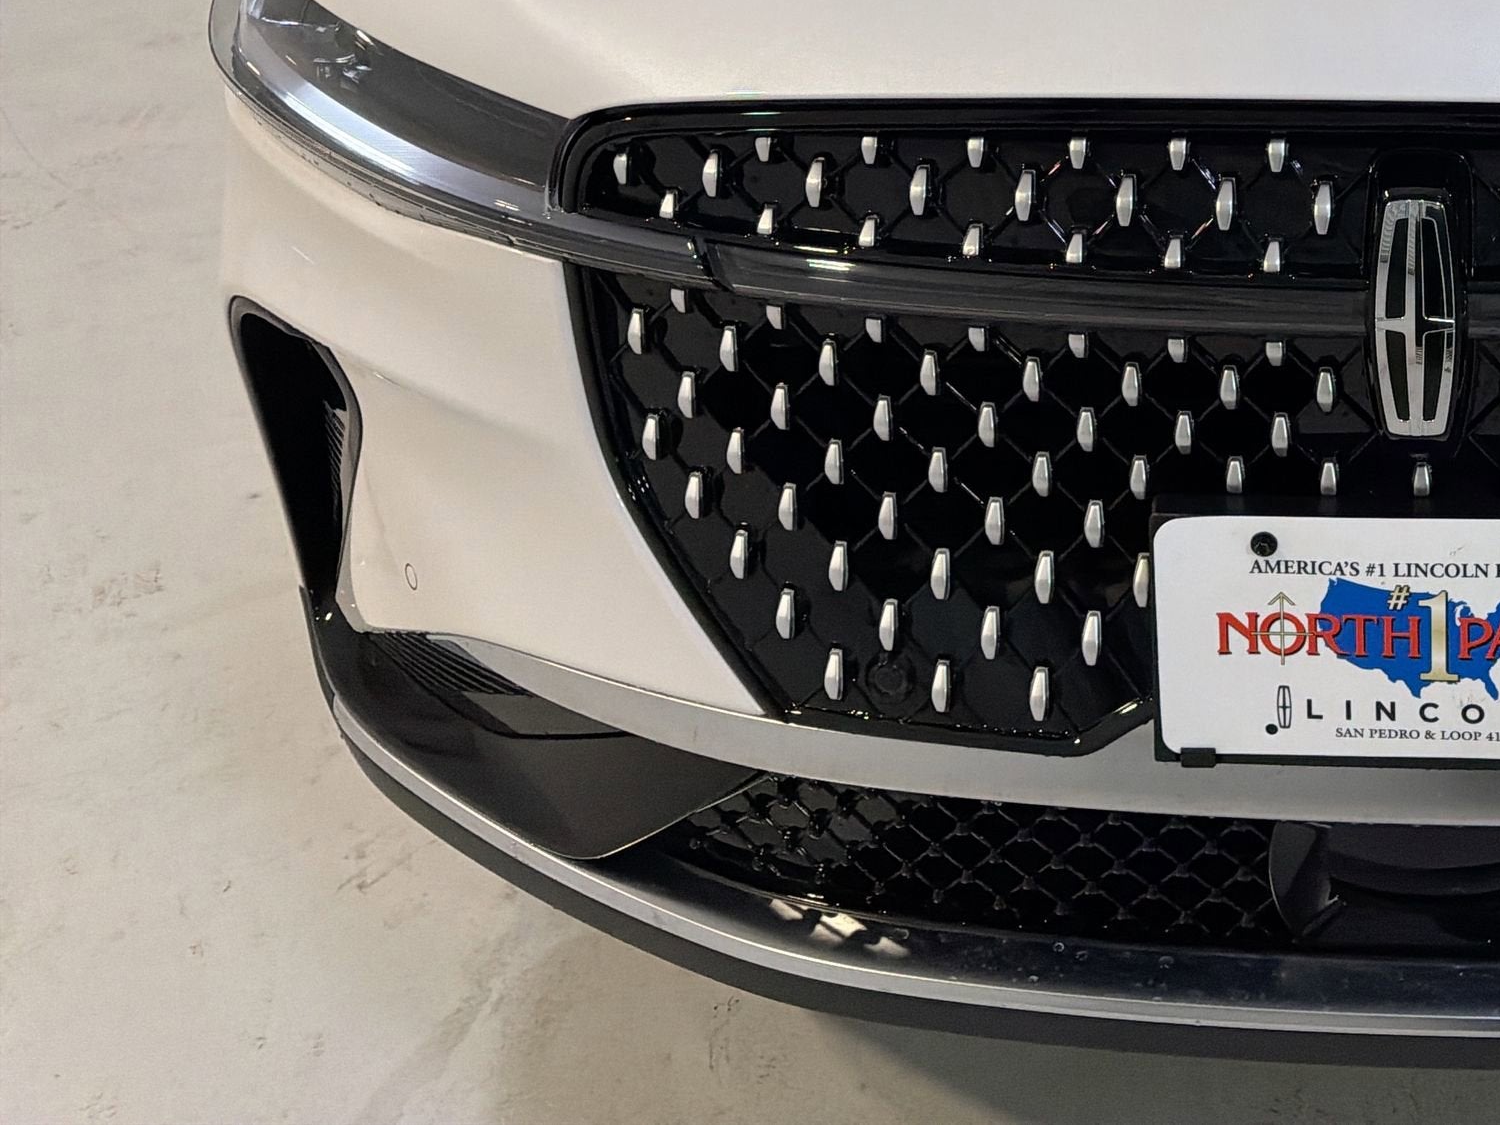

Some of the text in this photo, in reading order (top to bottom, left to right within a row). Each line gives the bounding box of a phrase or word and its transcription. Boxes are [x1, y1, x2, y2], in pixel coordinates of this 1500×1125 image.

[1249, 559, 1360, 578] AMERICA'S
[1365, 562, 1386, 578] #1
[1392, 562, 1489, 579] LINCOLN
[1216, 610, 1422, 660] NORTH
[1335, 728, 1364, 740] SAN
[1368, 728, 1421, 741] PEDRO
[1424, 729, 1437, 741] &
[1440, 730, 1482, 742] LOOP
